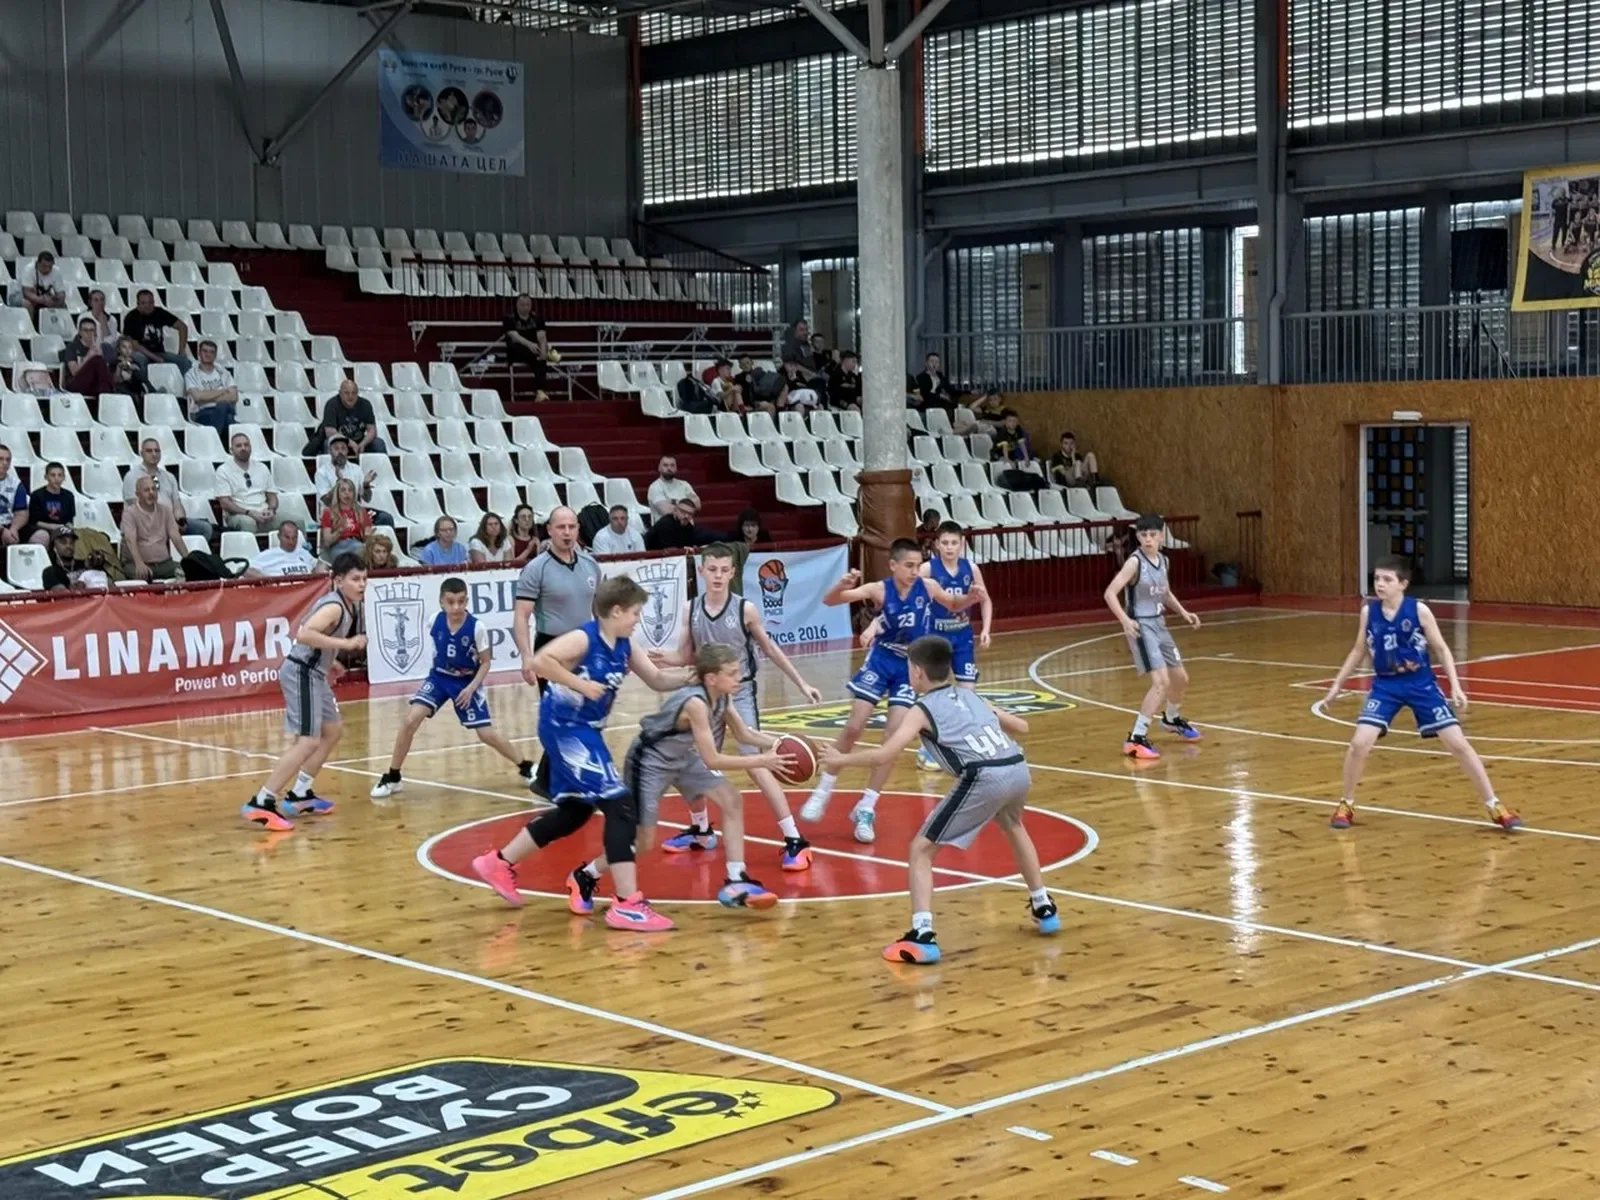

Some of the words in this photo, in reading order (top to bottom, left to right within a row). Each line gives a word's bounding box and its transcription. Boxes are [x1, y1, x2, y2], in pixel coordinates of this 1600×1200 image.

[476, 156, 507, 172] ЦЕЛ
[897, 612, 916, 628] 23
[798, 625, 828, 641] 2016
[52, 616, 293, 681] LINAMAR
[1383, 633, 1398, 651] 21
[446, 644, 457, 658] 6
[175, 676, 221, 693] Power
[221, 672, 237, 687] to
[896, 684, 916, 700] 23
[466, 708, 476, 721] 6
[1432, 706, 1453, 721] 21
[963, 725, 1011, 757] 44
[33, 1074, 466, 1189] ВОЛЕЙ
[201, 1085, 572, 1185] СУПЕР
[368, 1091, 738, 1194] efbet
